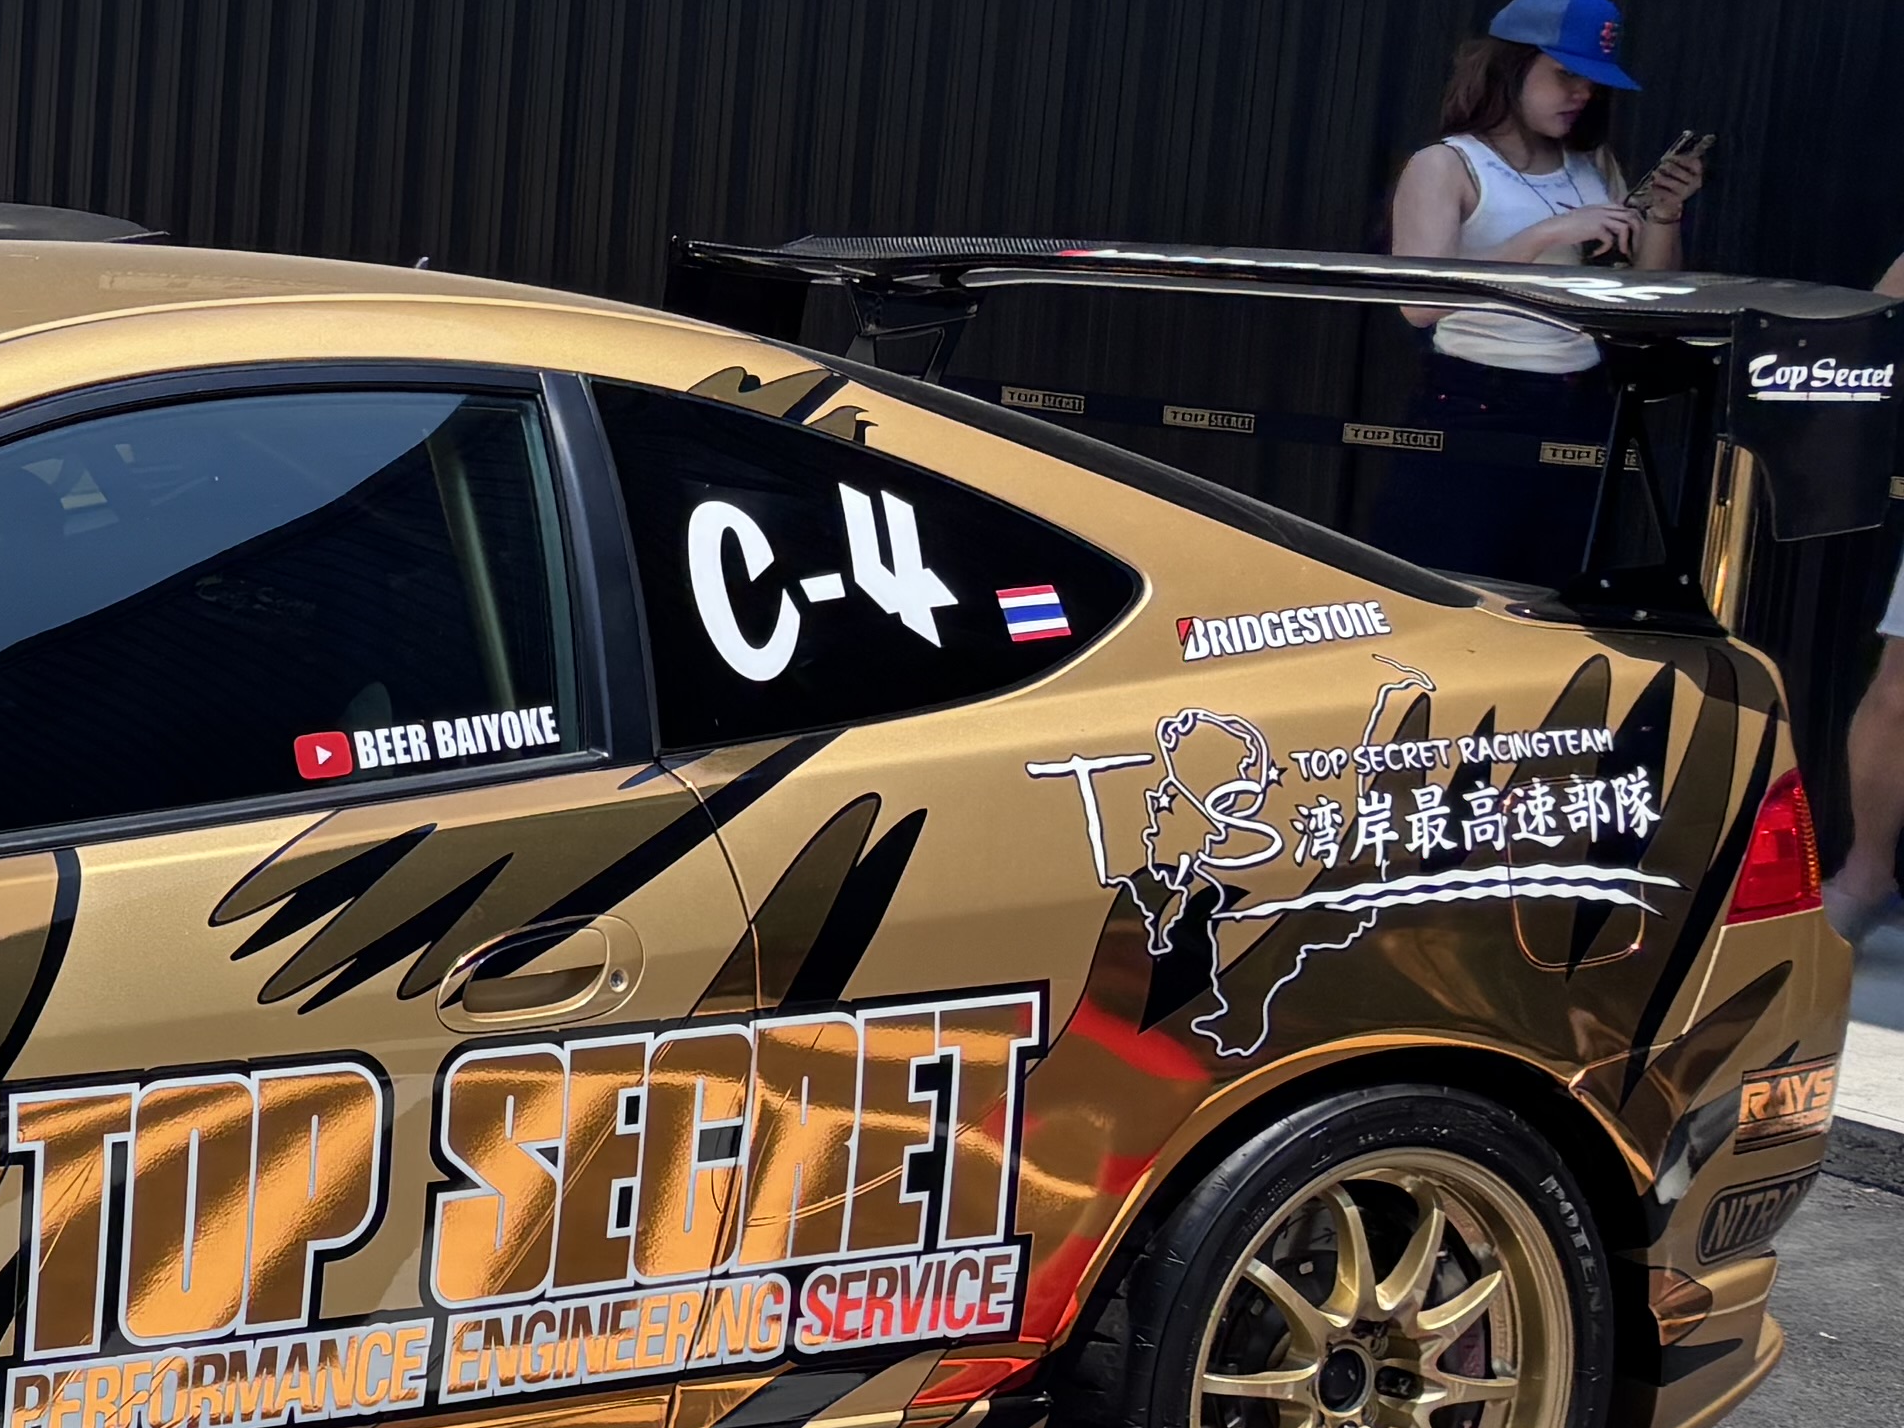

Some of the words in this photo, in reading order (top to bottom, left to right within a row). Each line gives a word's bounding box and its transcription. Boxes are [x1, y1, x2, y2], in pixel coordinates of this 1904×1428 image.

[1748, 354, 1809, 391] Top
[1810, 358, 1895, 388] Secret
[1170, 409, 1206, 423] TOP
[1351, 427, 1390, 441] TOP
[1393, 430, 1440, 448] SECRET
[1548, 446, 1591, 461] TOP
[687, 481, 960, 682] C-4
[1176, 600, 1392, 662] BRIDGESTONE
[352, 724, 431, 770] BEER
[432, 705, 561, 760] BAIYOKE
[1290, 747, 1347, 781] TOP
[1352, 737, 1452, 775] SECRET
[1291, 765, 1663, 872] 湾岸最高速部隊
[1737, 1066, 1837, 1124] RAYS
[7, 1060, 385, 1363] TOP
[427, 992, 1040, 1311] SECRET
[439, 1272, 791, 1405] ENGINEERING
[796, 1247, 1020, 1357] SERVICE
